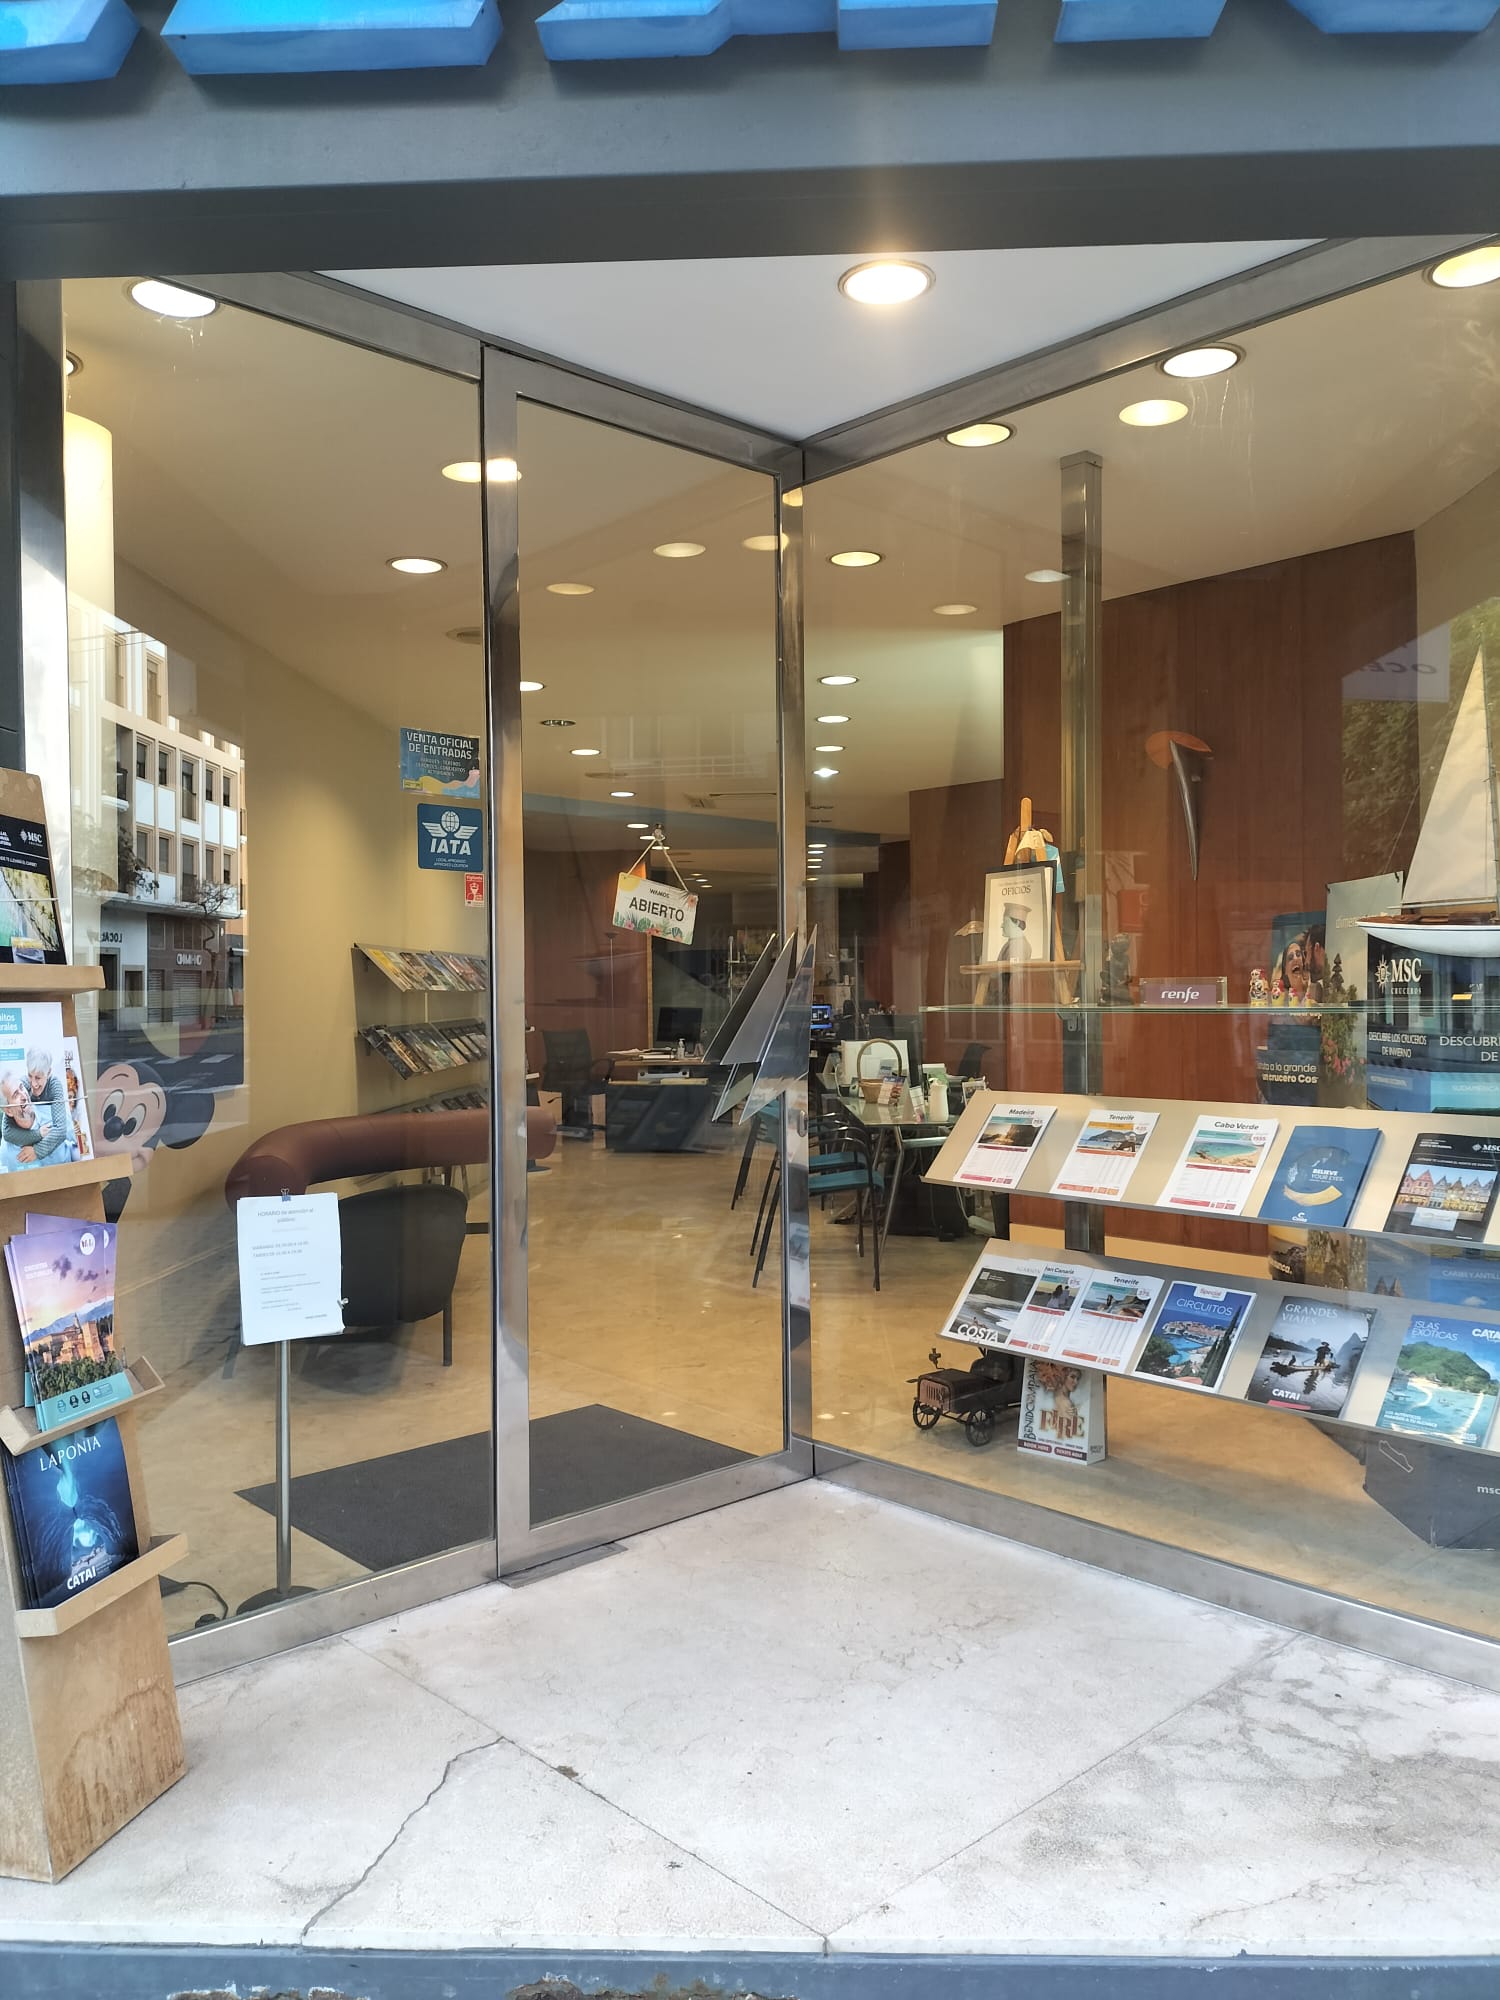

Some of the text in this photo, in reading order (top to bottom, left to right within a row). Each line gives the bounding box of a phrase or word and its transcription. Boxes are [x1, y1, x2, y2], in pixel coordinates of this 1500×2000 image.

[407, 731, 474, 750] VENTA OFICIAL
[409, 742, 472, 760] DE ENTRADAS
[27, 832, 43, 843] MSC
[430, 838, 471, 855] IATA
[1001, 885, 1032, 896] OFICIOS
[629, 896, 685, 922] ABIERTO
[1391, 958, 1421, 982] MSC
[1160, 987, 1200, 1004] renfe
[1481, 1051, 1498, 1062] DE
[1284, 1064, 1317, 1075] grande
[1269, 1074, 1297, 1083] crucero
[1298, 1074, 1319, 1084] Cos
[1009, 1108, 1035, 1116] Madeira
[1214, 1121, 1235, 1129] Cabo
[1114, 1276, 1139, 1285] Tenerife
[1176, 1298, 1233, 1316] CIRCUITOS
[1285, 1304, 1338, 1318] GRANDES
[1282, 1313, 1316, 1325] VIAJES
[1415, 1320, 1440, 1330] ISLAS
[957, 1323, 999, 1343] COSTA
[1272, 1388, 1301, 1401] CATAI
[40, 1435, 101, 1472] LAPONIA
[67, 1566, 97, 1590] CATAI
